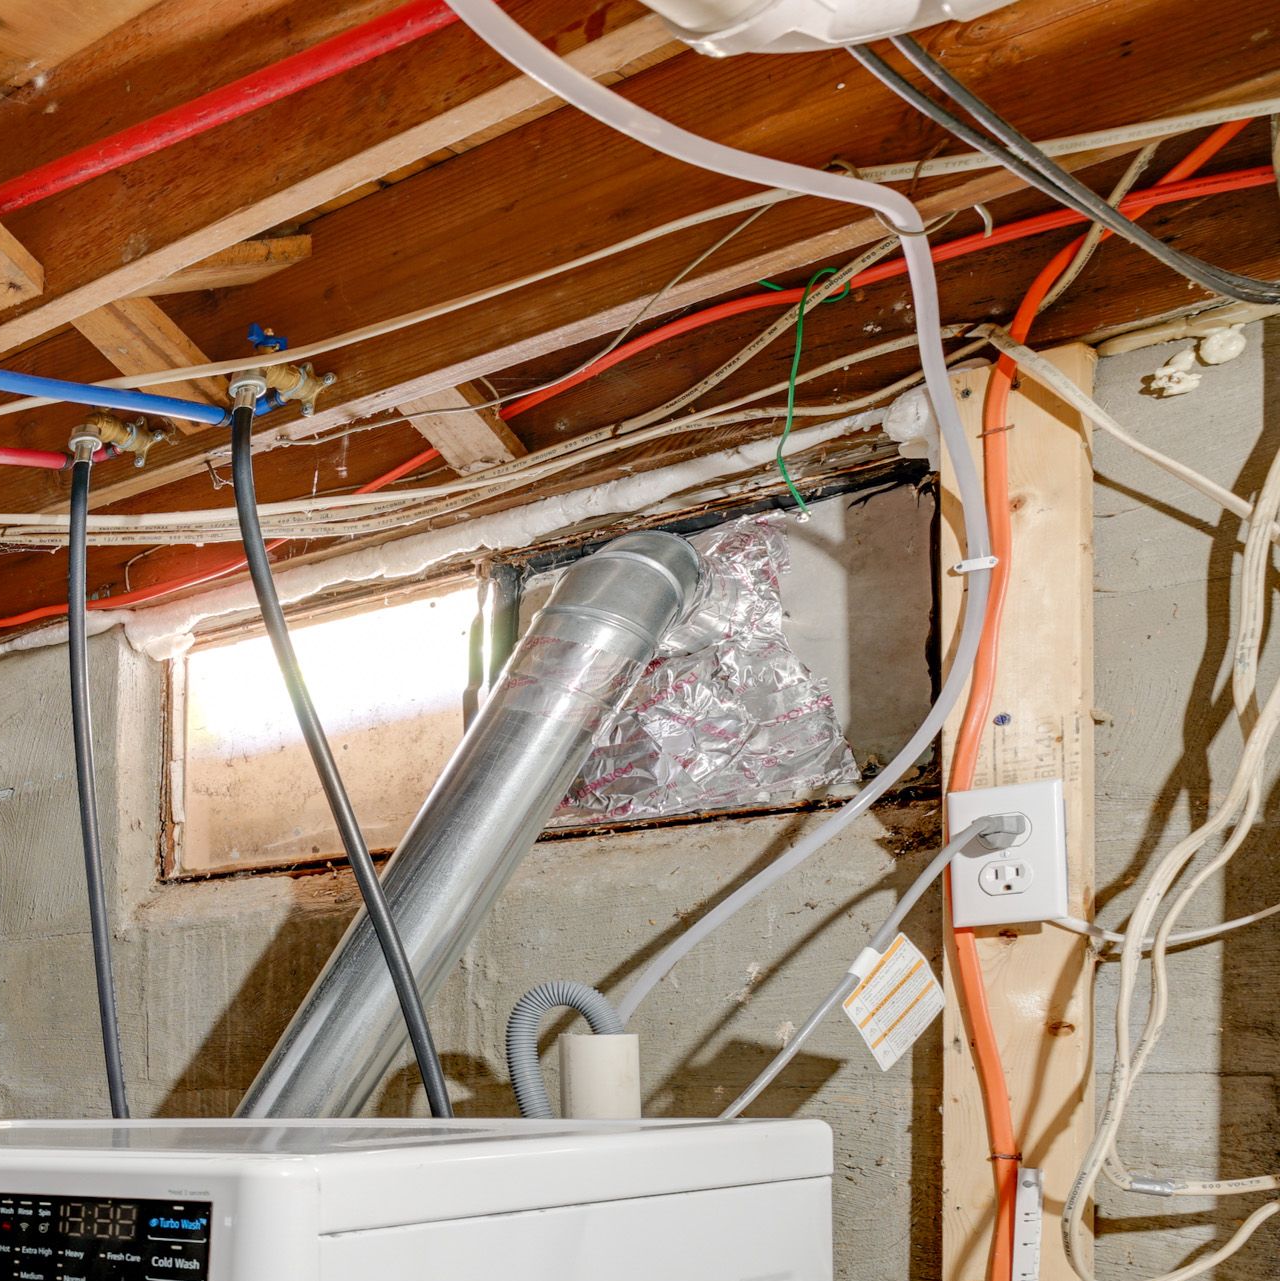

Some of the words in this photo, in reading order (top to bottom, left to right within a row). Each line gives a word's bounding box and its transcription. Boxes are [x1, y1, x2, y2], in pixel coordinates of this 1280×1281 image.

[944, 159, 970, 168] TYPE
[748, 336, 765, 352] TYPE
[38, 1208, 51, 1216] Spin
[160, 1217, 180, 1229] Turbo
[22, 1246, 38, 1254] Extra
[38, 1247, 52, 1257] High
[65, 1250, 85, 1259] Heavy
[107, 1252, 125, 1261] Fresh
[125, 1253, 141, 1262] Care
[151, 1256, 172, 1268] Cold
[175, 1258, 200, 1270] Wash
[20, 1271, 44, 1280] Medium
